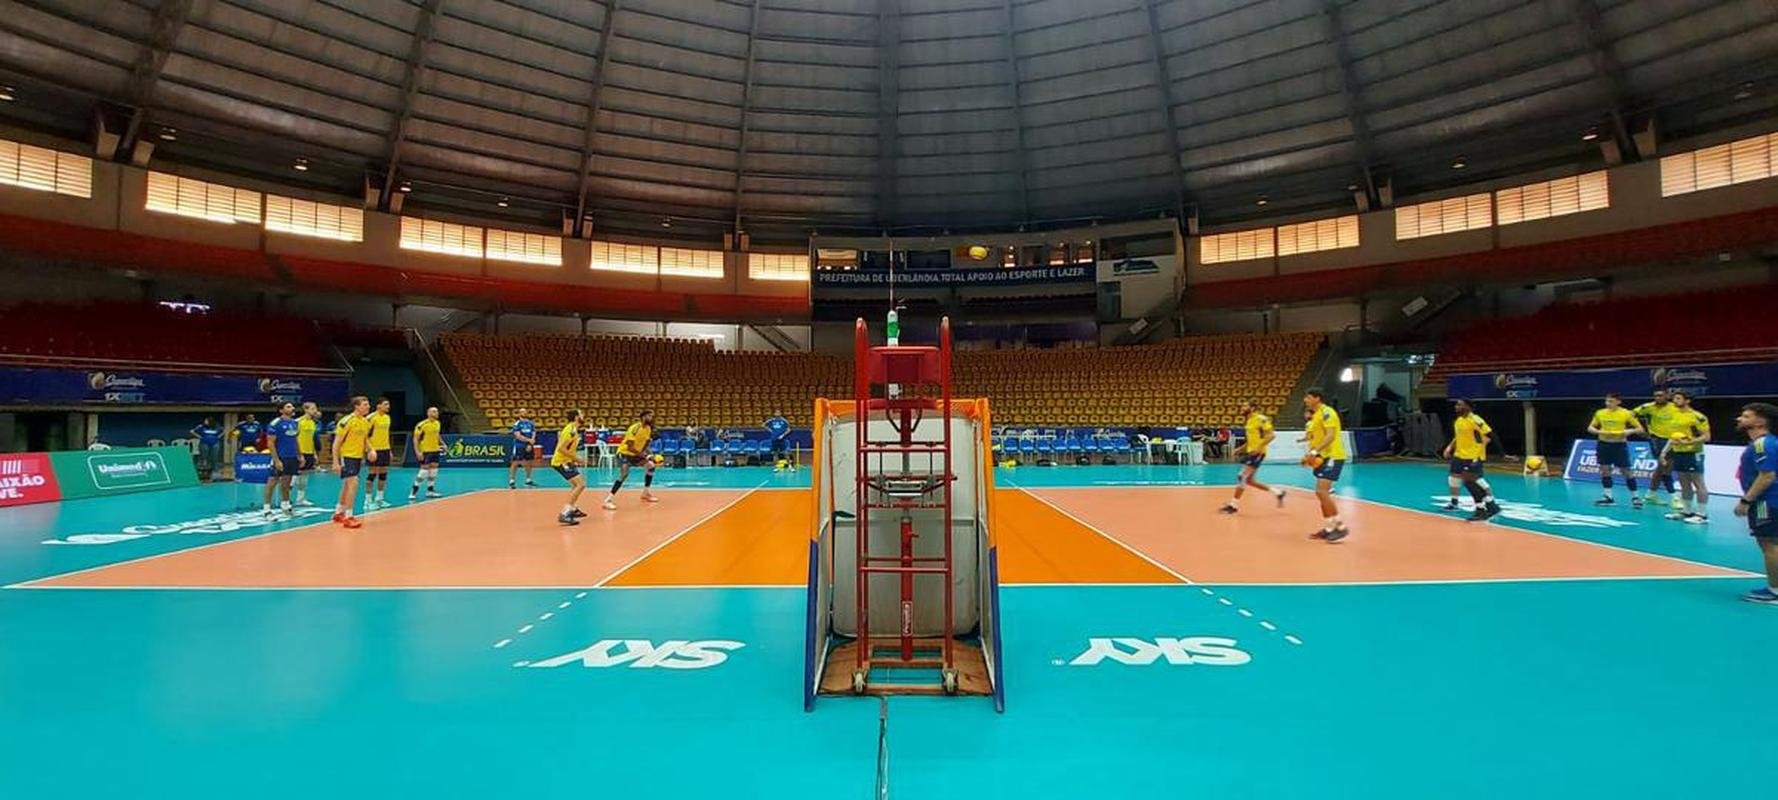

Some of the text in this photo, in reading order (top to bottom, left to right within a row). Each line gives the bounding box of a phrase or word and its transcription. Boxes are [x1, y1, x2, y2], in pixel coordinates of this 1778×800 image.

[872, 273, 885, 283] DE
[941, 273, 965, 282] TOTAL
[967, 272, 994, 281] APOIO
[995, 271, 1007, 281] AO
[1009, 270, 1046, 280] ESPORTE
[1049, 269, 1056, 278] E
[464, 444, 506, 456] BRASIL
[528, 639, 747, 668] SKY
[1068, 636, 1252, 666] SKY
